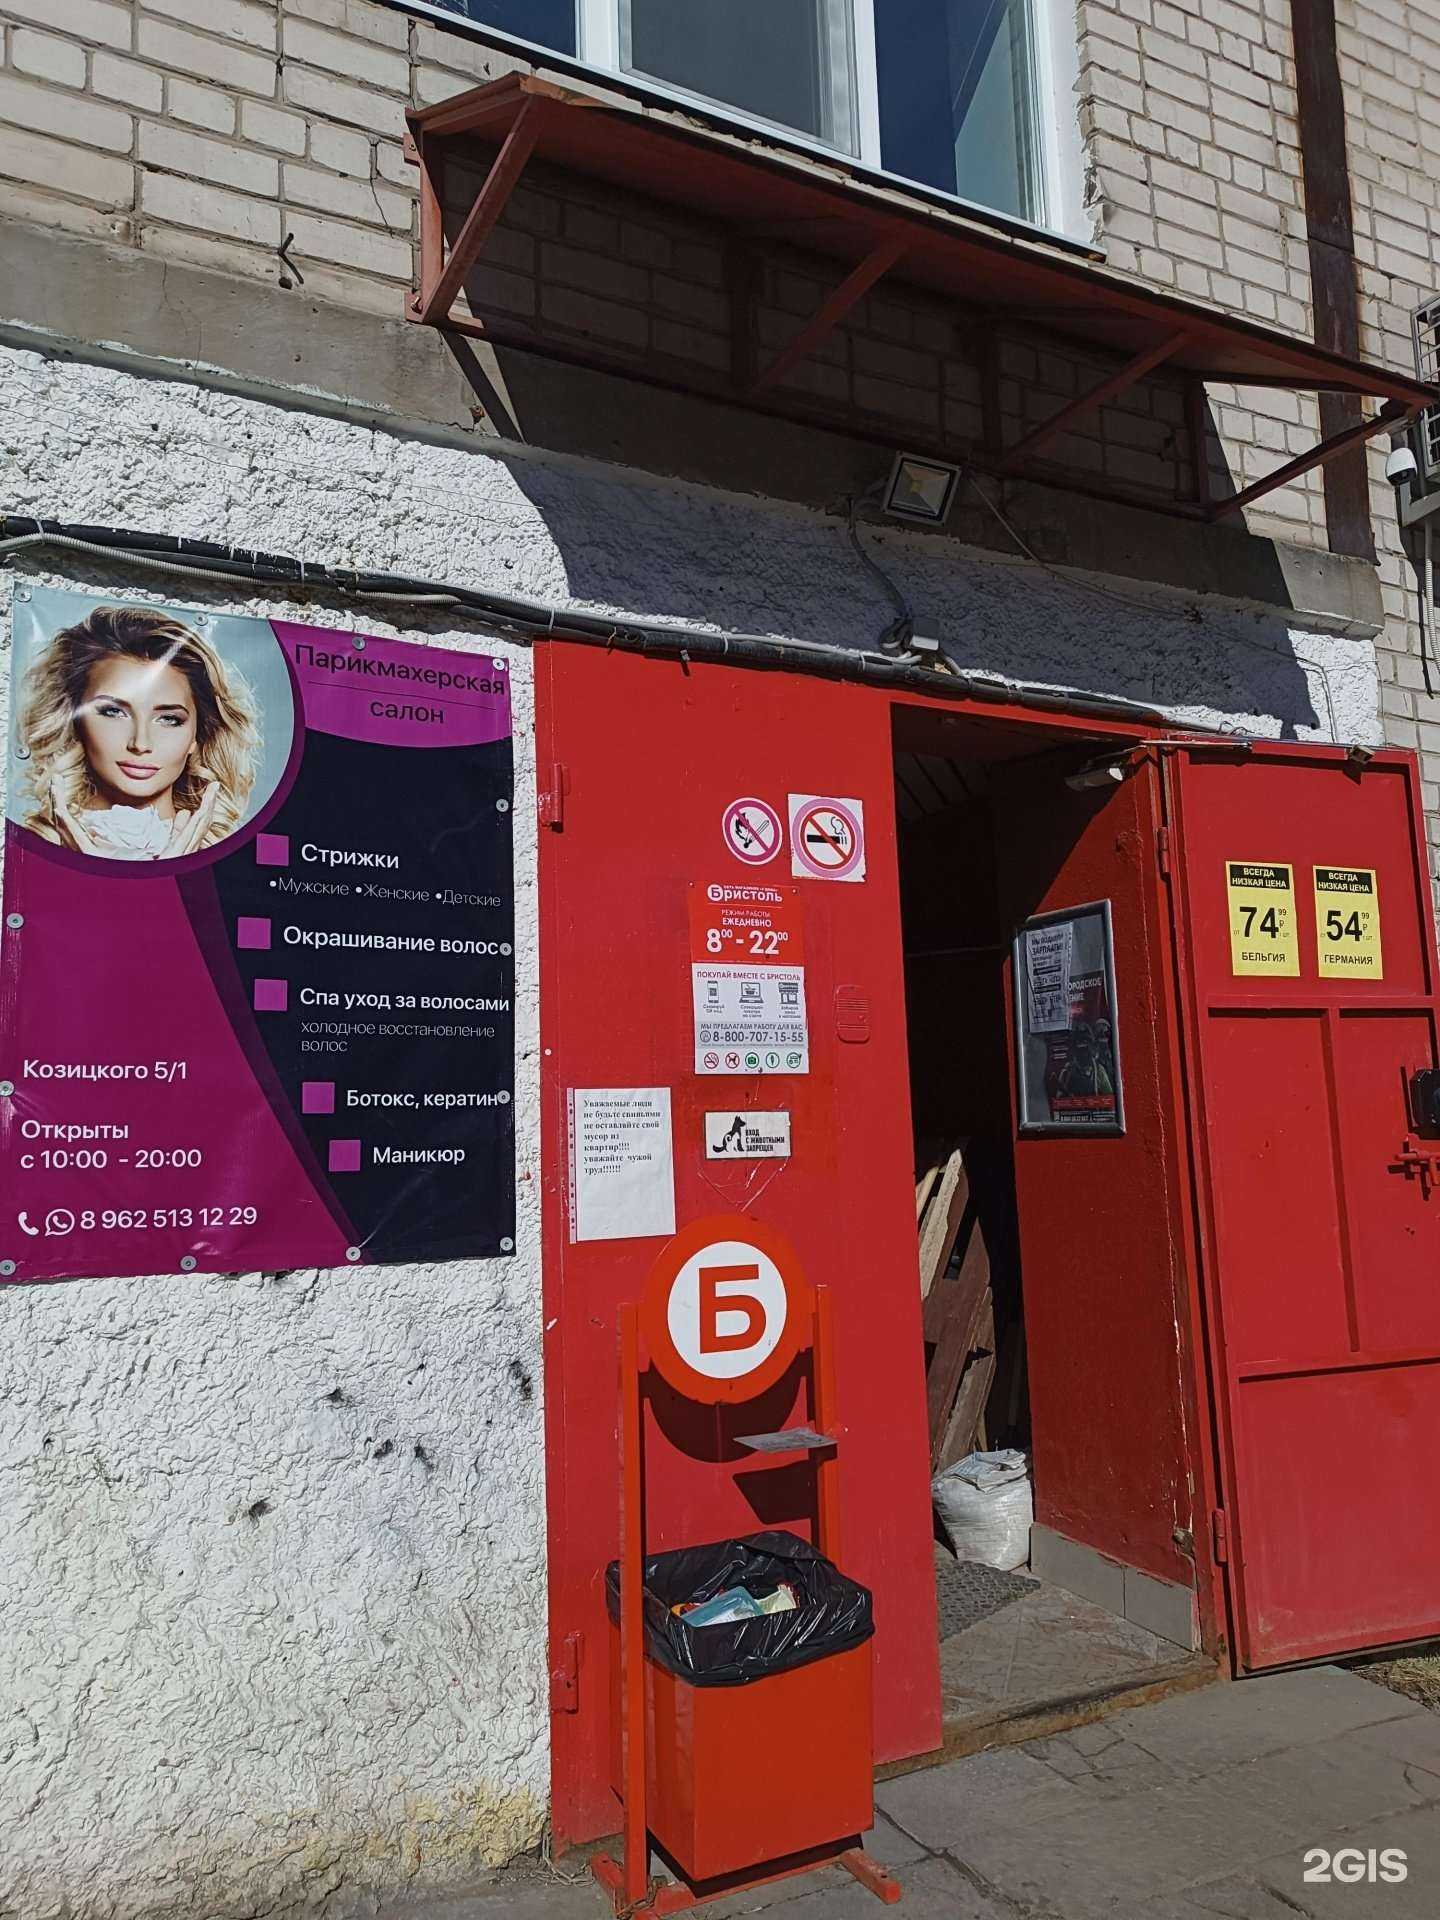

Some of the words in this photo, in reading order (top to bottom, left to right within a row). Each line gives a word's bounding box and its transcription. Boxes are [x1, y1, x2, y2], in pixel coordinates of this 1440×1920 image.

[295, 644, 505, 695] Парикмахерская
[370, 700, 444, 724] салон
[301, 844, 399, 868] Стрижки
[1243, 868, 1274, 877] ВСЕГДА
[1329, 872, 1358, 882] ВСЕГДА
[1232, 877, 1264, 886] НИЗКАЯ
[1265, 879, 1287, 888] ЦЕНА
[1318, 882, 1348, 891] НИЗКАЯ
[1349, 884, 1370, 892] ЦЕНА
[279, 877, 349, 896] Мужские
[364, 884, 430, 901] Женские
[443, 889, 501, 907] Детские
[707, 884, 783, 902] Бристоль
[722, 917, 772, 927] ЕЖЕДНЕВНО
[1239, 906, 1279, 939] 74
[1327, 910, 1362, 942] 54
[284, 926, 435, 951] Окрашивание
[441, 939, 498, 955] волос
[1242, 952, 1286, 962] БЕЛЬГИЯ
[1324, 954, 1373, 964] ГЕРМАНИЯ
[697, 971, 732, 979] ПОКУПАЙ
[300, 988, 339, 1006] Спа
[344, 995, 391, 1010] уход
[395, 996, 415, 1008] за
[420, 996, 509, 1011] волосами
[301, 1022, 376, 1036] холодное
[379, 1023, 495, 1037] восстановление
[713, 1032, 804, 1042] 8-800-707-15-55
[301, 1040, 348, 1052] волос
[23, 1060, 148, 1081] Козицкого
[154, 1062, 187, 1082] 5/1
[347, 1090, 420, 1109] Ботокс,
[424, 1094, 498, 1110] кератин
[595, 1110, 620, 1119] будьте
[21, 1120, 129, 1142] Открыты
[595, 1121, 640, 1129] оставляйте
[584, 1133, 609, 1142] мусор
[20, 1154, 34, 1168] с
[41, 1150, 107, 1168] 10:00
[135, 1149, 201, 1168] 20:00
[373, 1147, 465, 1165] Маникюр
[584, 1154, 623, 1164] уважайте
[627, 1153, 652, 1163] чужой
[80, 1210, 95, 1229] 8
[101, 1210, 147, 1228] 962
[153, 1209, 193, 1227] 513
[199, 1208, 223, 1225] 12
[229, 1207, 257, 1225] 29
[699, 1264, 766, 1354] Б
